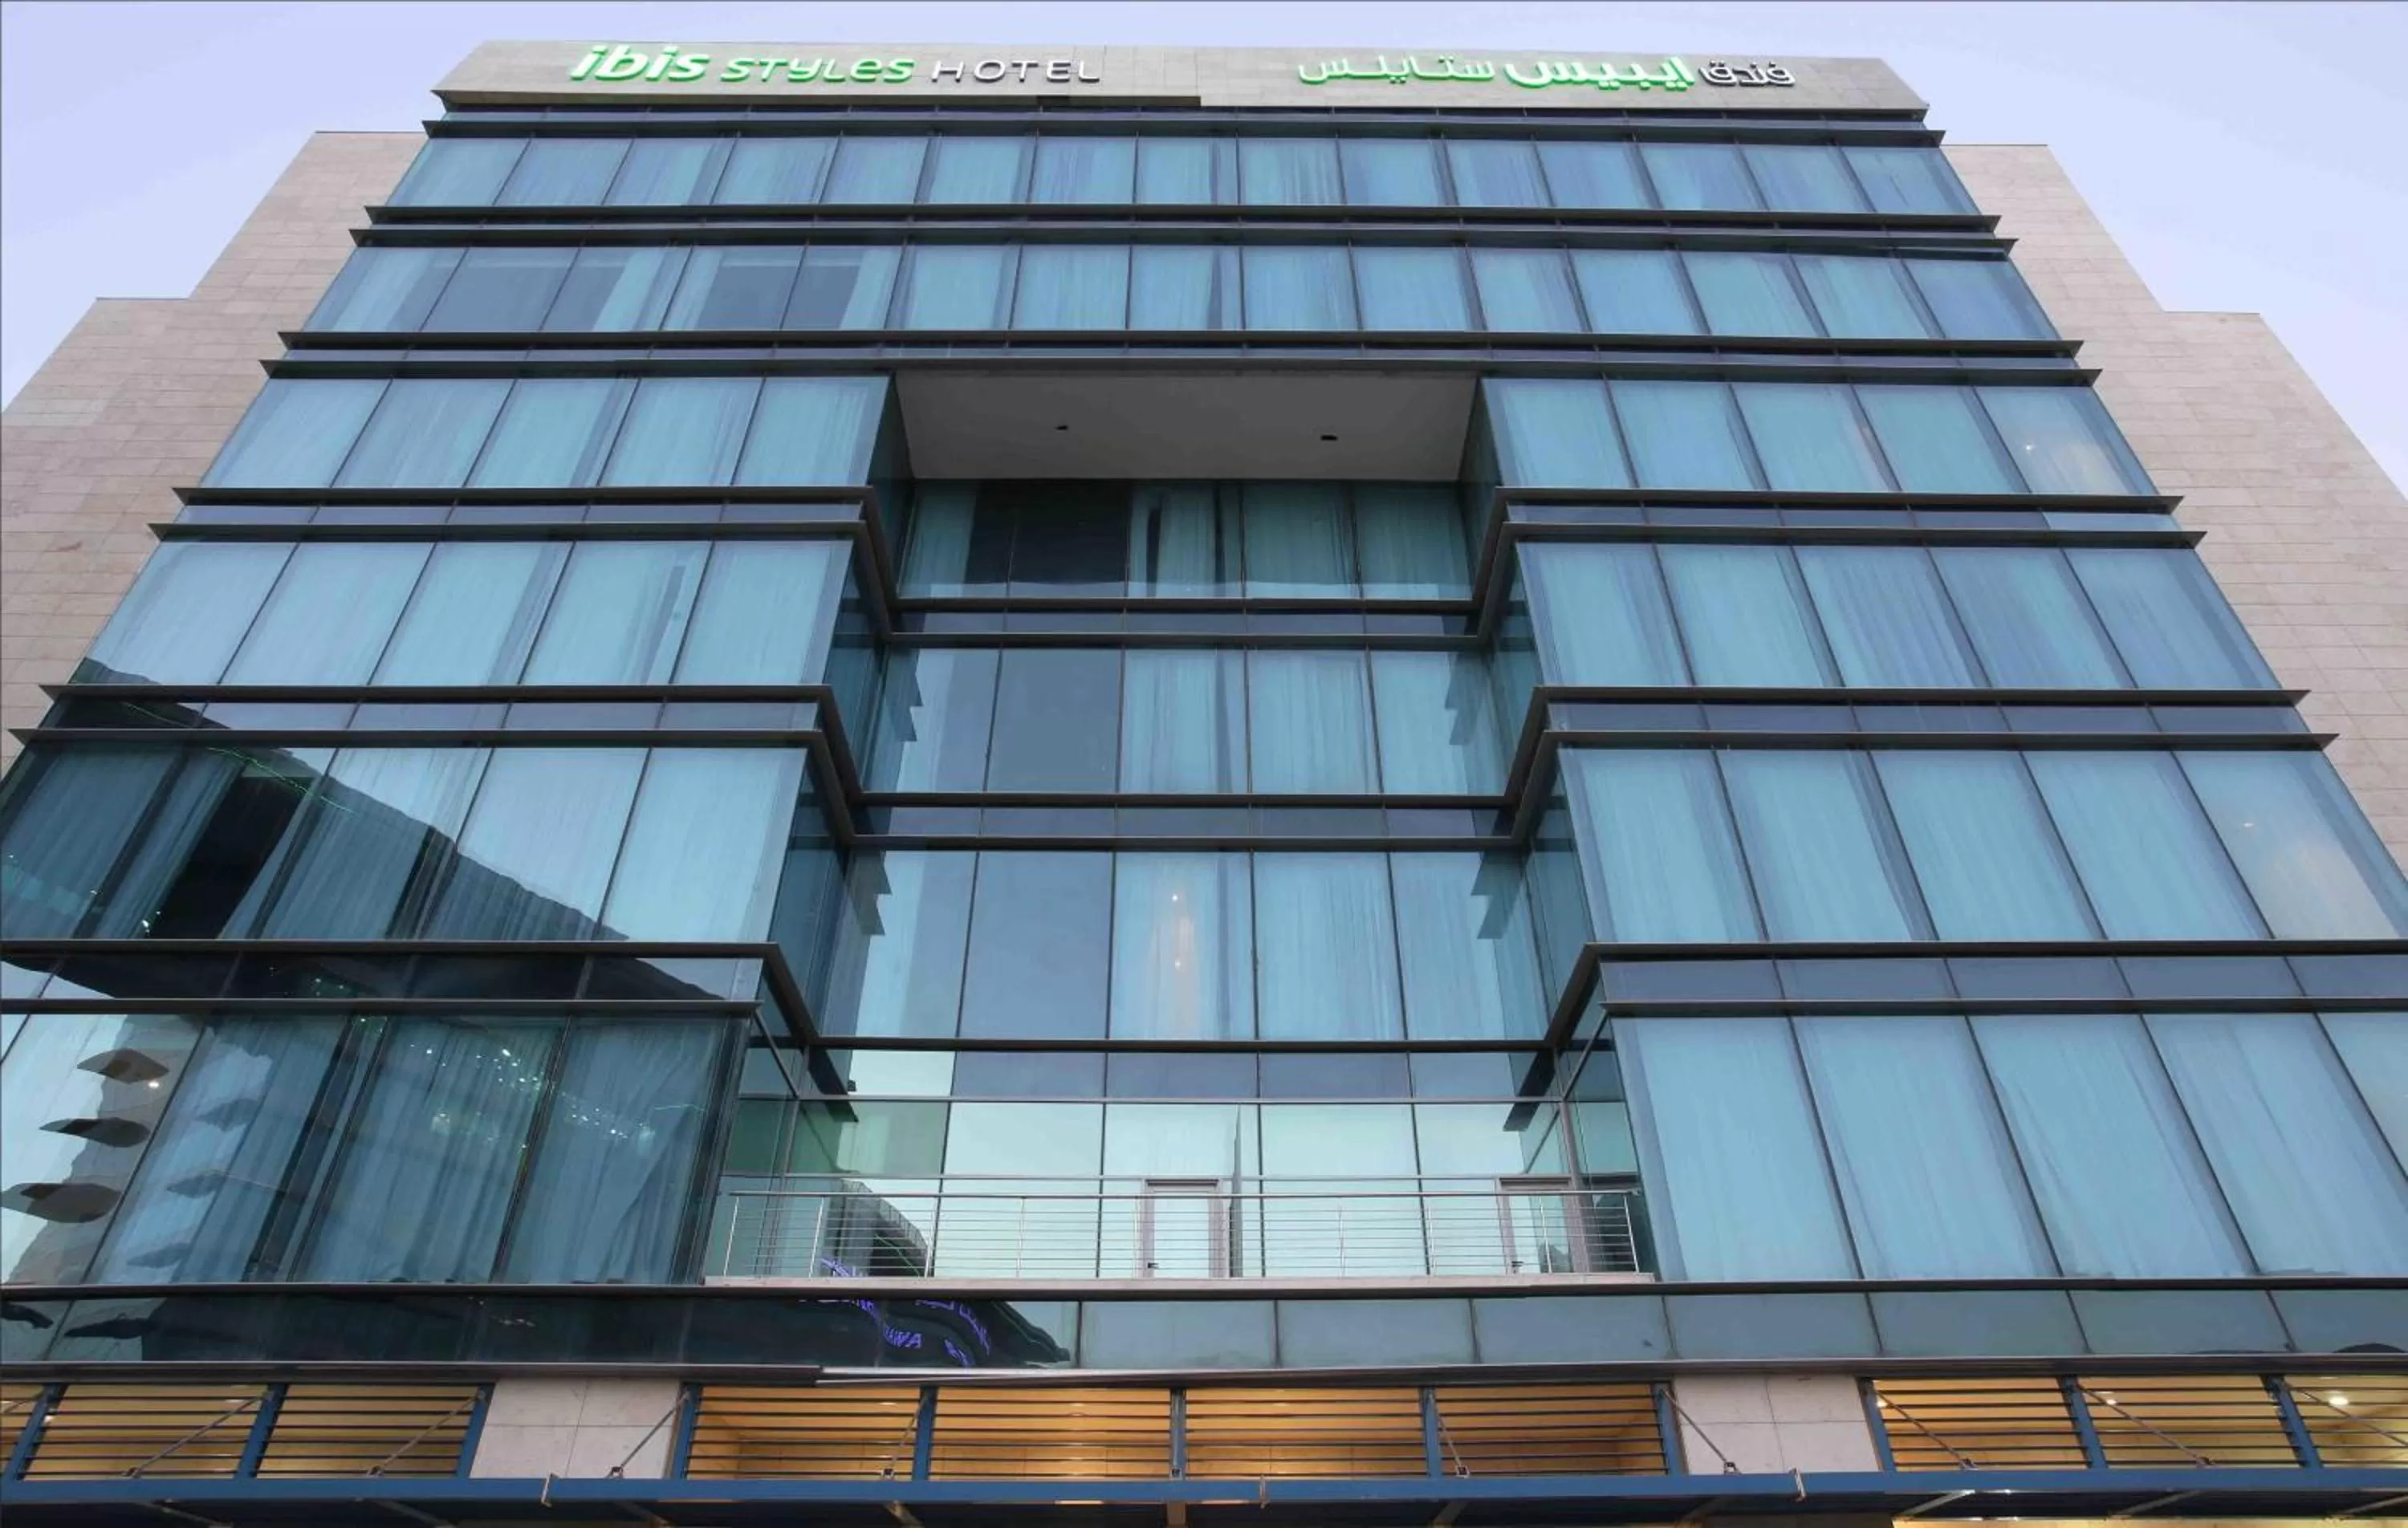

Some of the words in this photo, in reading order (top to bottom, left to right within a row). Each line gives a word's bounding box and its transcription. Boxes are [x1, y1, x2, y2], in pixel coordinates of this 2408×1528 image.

[570, 43, 711, 81] ibis
[930, 59, 1101, 83] HOTEL
[1298, 55, 1496, 84] ستايلس
[1503, 55, 1696, 91] ايبيس
[1698, 59, 1797, 87] فندق
